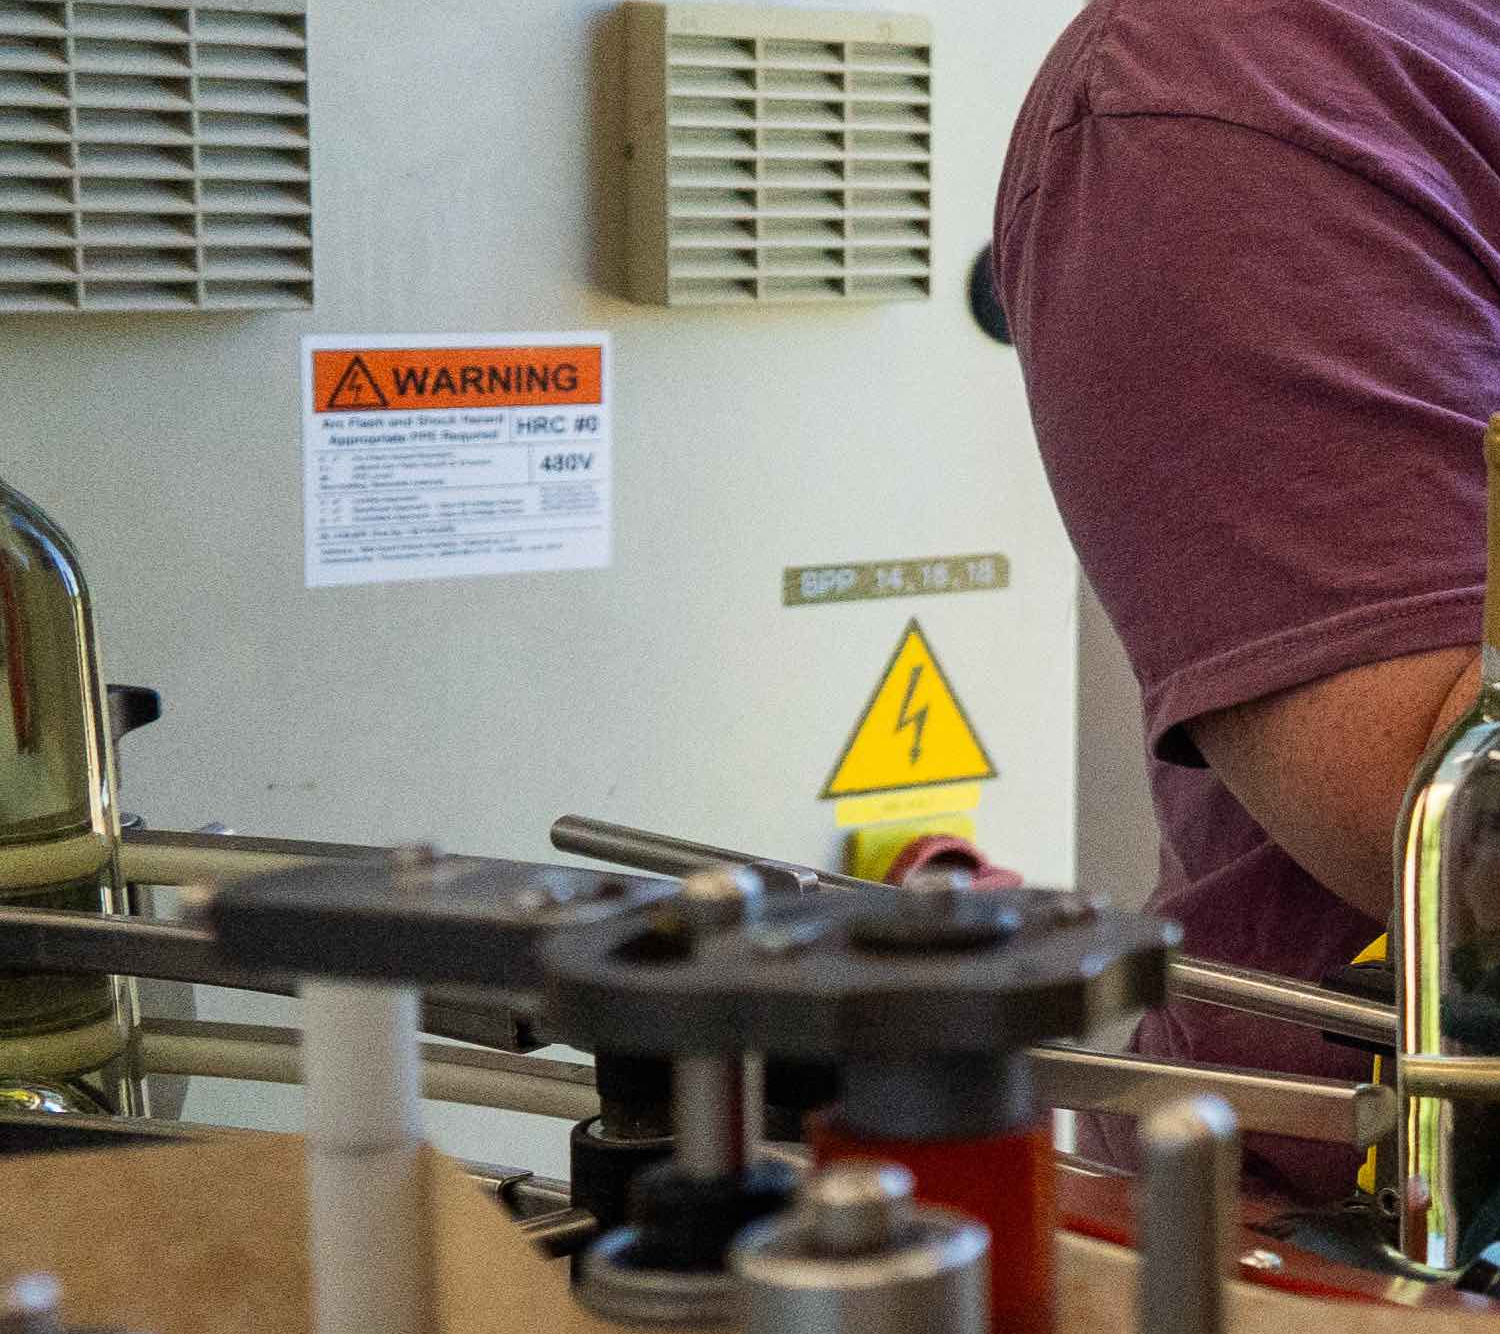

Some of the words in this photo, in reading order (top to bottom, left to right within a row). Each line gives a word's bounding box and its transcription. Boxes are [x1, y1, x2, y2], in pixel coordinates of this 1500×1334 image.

[391, 362, 579, 397] WARNING
[515, 415, 567, 435] HRC
[539, 452, 594, 473] 480V
